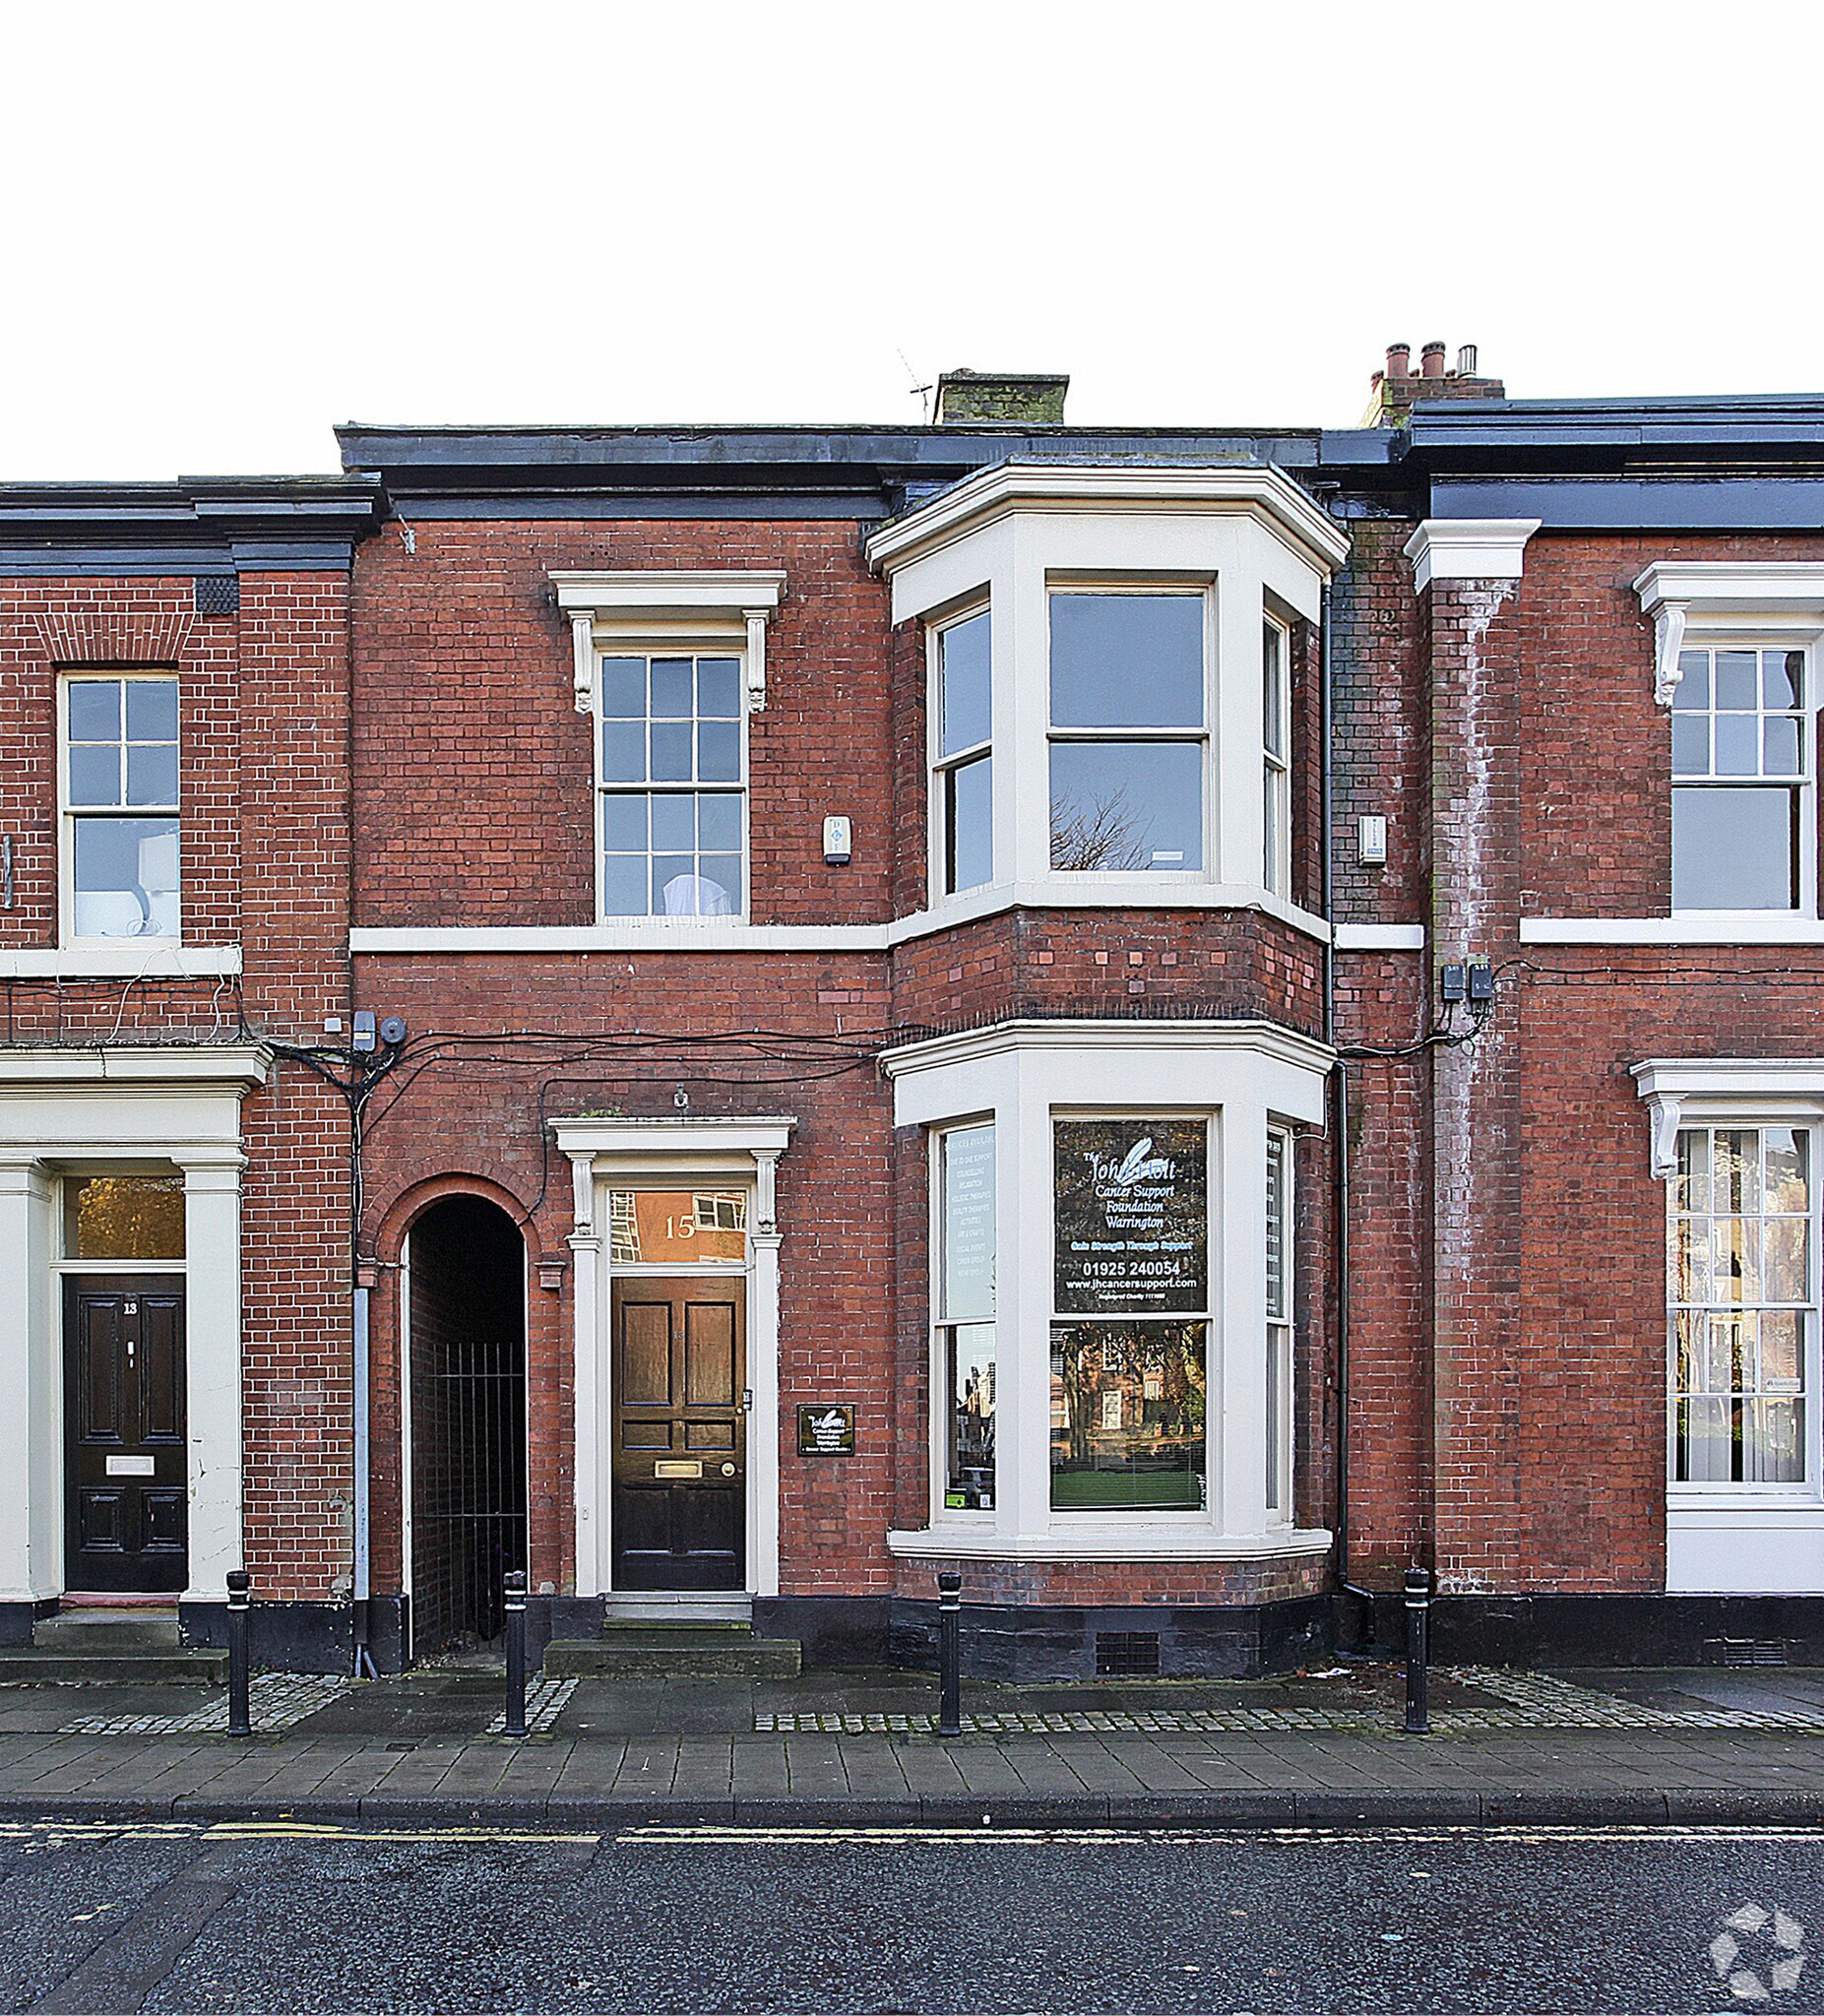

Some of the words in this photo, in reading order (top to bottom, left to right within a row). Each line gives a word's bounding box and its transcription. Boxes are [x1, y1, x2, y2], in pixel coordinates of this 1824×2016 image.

[1095, 1185, 1132, 1197] Cancer
[1133, 1185, 1175, 1199] Support
[1106, 1199, 1164, 1213] Foundation
[666, 1215, 695, 1239] 15
[1105, 1215, 1164, 1230] Warrington
[1083, 1262, 1126, 1276] 01925
[1129, 1261, 1180, 1276] 240054
[1066, 1279, 1197, 1290] www.jhcancersupport.com
[124, 1303, 137, 1314] 13
